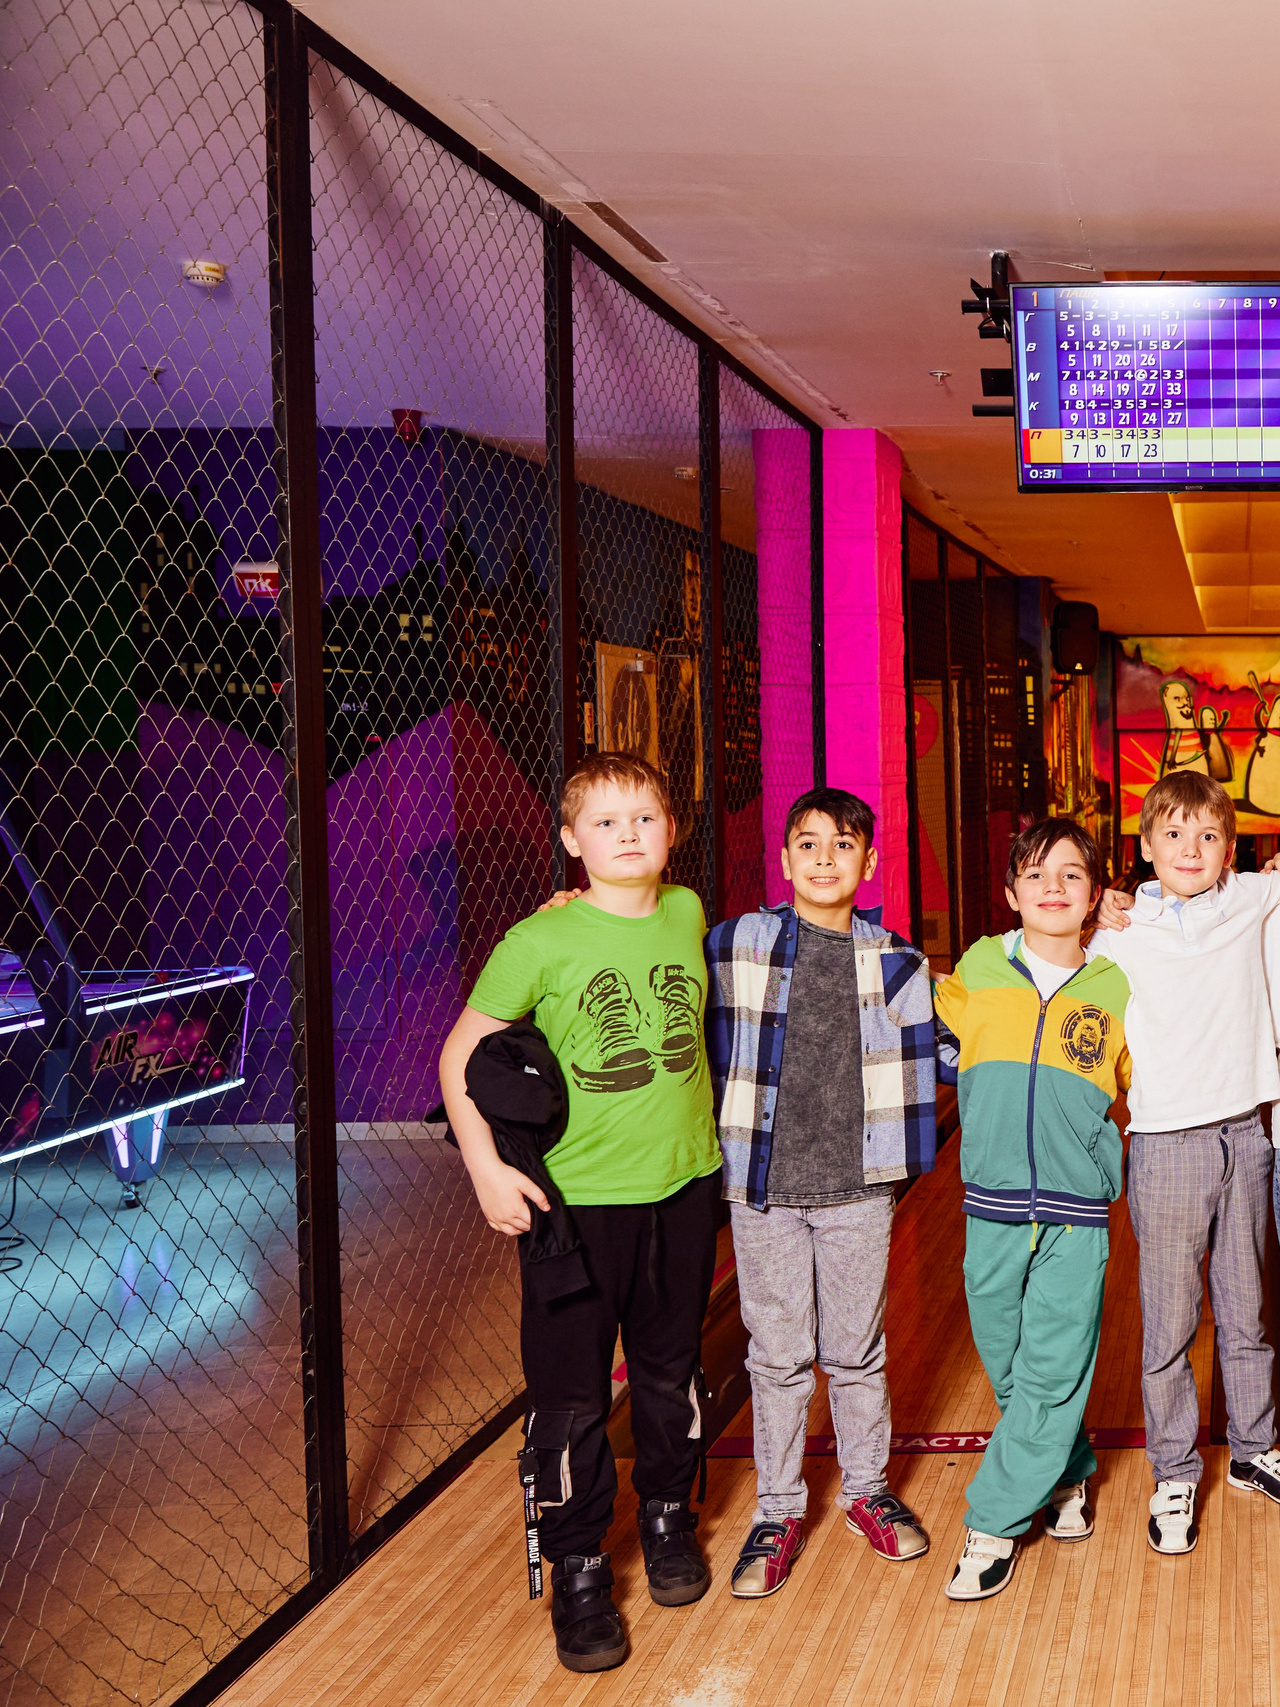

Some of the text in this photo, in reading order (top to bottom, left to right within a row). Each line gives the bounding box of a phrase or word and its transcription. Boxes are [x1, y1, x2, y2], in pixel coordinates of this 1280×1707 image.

[1032, 291, 1038, 307] 1
[1067, 300, 1072, 309] 1
[1092, 300, 1099, 309] 2
[1193, 299, 1201, 308] 6
[1219, 299, 1226, 308] 7
[1244, 299, 1252, 308] 8
[1269, 298, 1277, 308] 9
[1067, 325, 1075, 337] 5
[1092, 325, 1100, 336] 8
[1117, 325, 1126, 336] 11
[1142, 325, 1151, 336] 11
[1166, 324, 1178, 336] 17
[1068, 355, 1076, 366] 5
[1093, 354, 1101, 366] 11
[1115, 354, 1131, 366] 20
[1140, 354, 1156, 366] 26
[1069, 384, 1078, 396] 8
[1092, 384, 1104, 395] 14
[1117, 384, 1129, 395] 19
[1142, 384, 1156, 395] 27
[1167, 383, 1181, 395] 33
[1070, 413, 1078, 425] 9
[1093, 413, 1106, 425] 13
[1118, 413, 1130, 425] 21
[1142, 413, 1157, 425] 24
[1167, 412, 1182, 424] 27
[1072, 445, 1079, 457] 7
[1095, 445, 1106, 457] 10
[1121, 444, 1131, 457] 17
[1144, 444, 1158, 457] 23
[1029, 469, 1056, 479] 0:31
[244, 578, 273, 592] ПК
[94, 1030, 139, 1072] AIR
